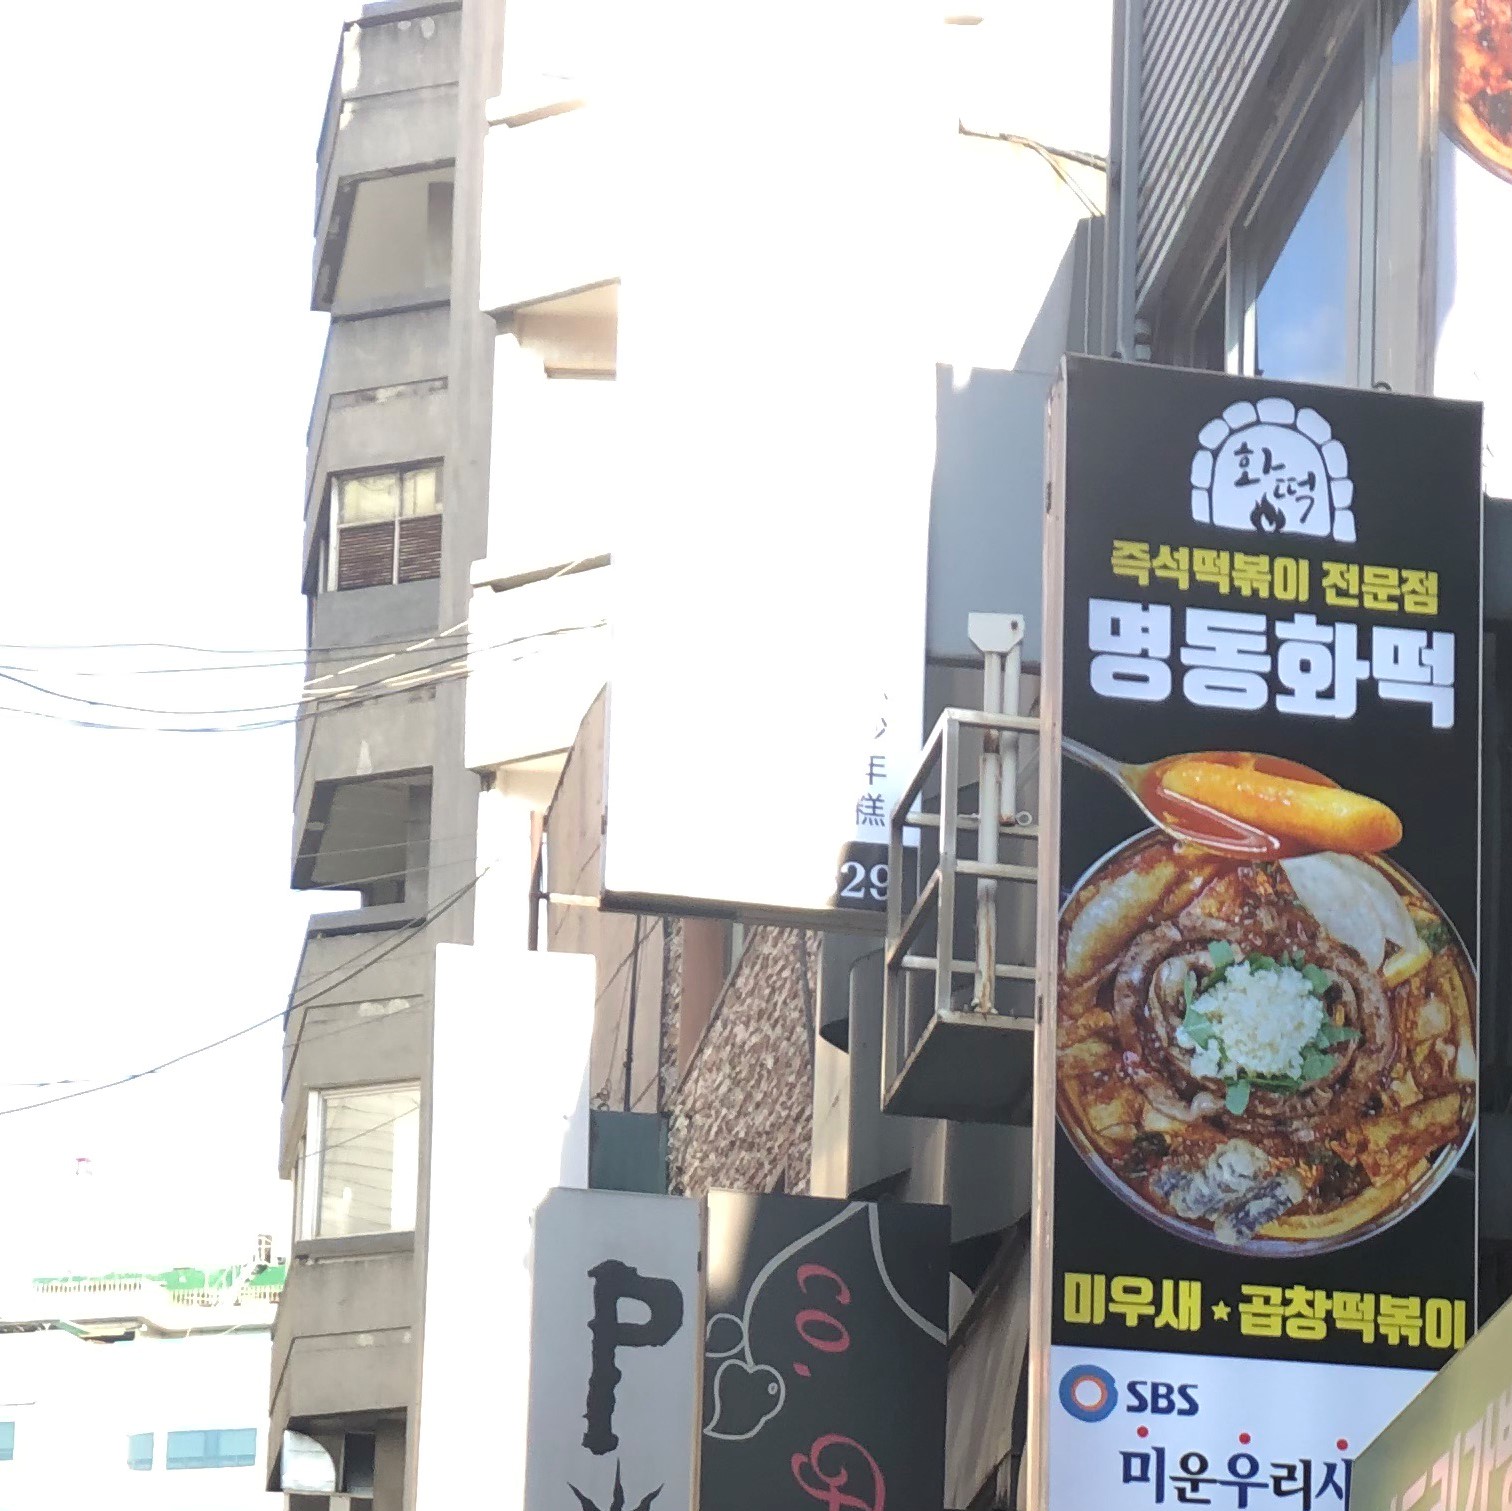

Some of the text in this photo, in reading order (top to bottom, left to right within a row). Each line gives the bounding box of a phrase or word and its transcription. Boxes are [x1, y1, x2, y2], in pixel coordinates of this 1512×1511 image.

[1110, 538, 1440, 616] 즉석떡볶이 전문점
[1087, 598, 1456, 730] 명동화떡
[1063, 1271, 1468, 1351] 미우새 곱창떡볶이
[1126, 1380, 1201, 1417] SBS
